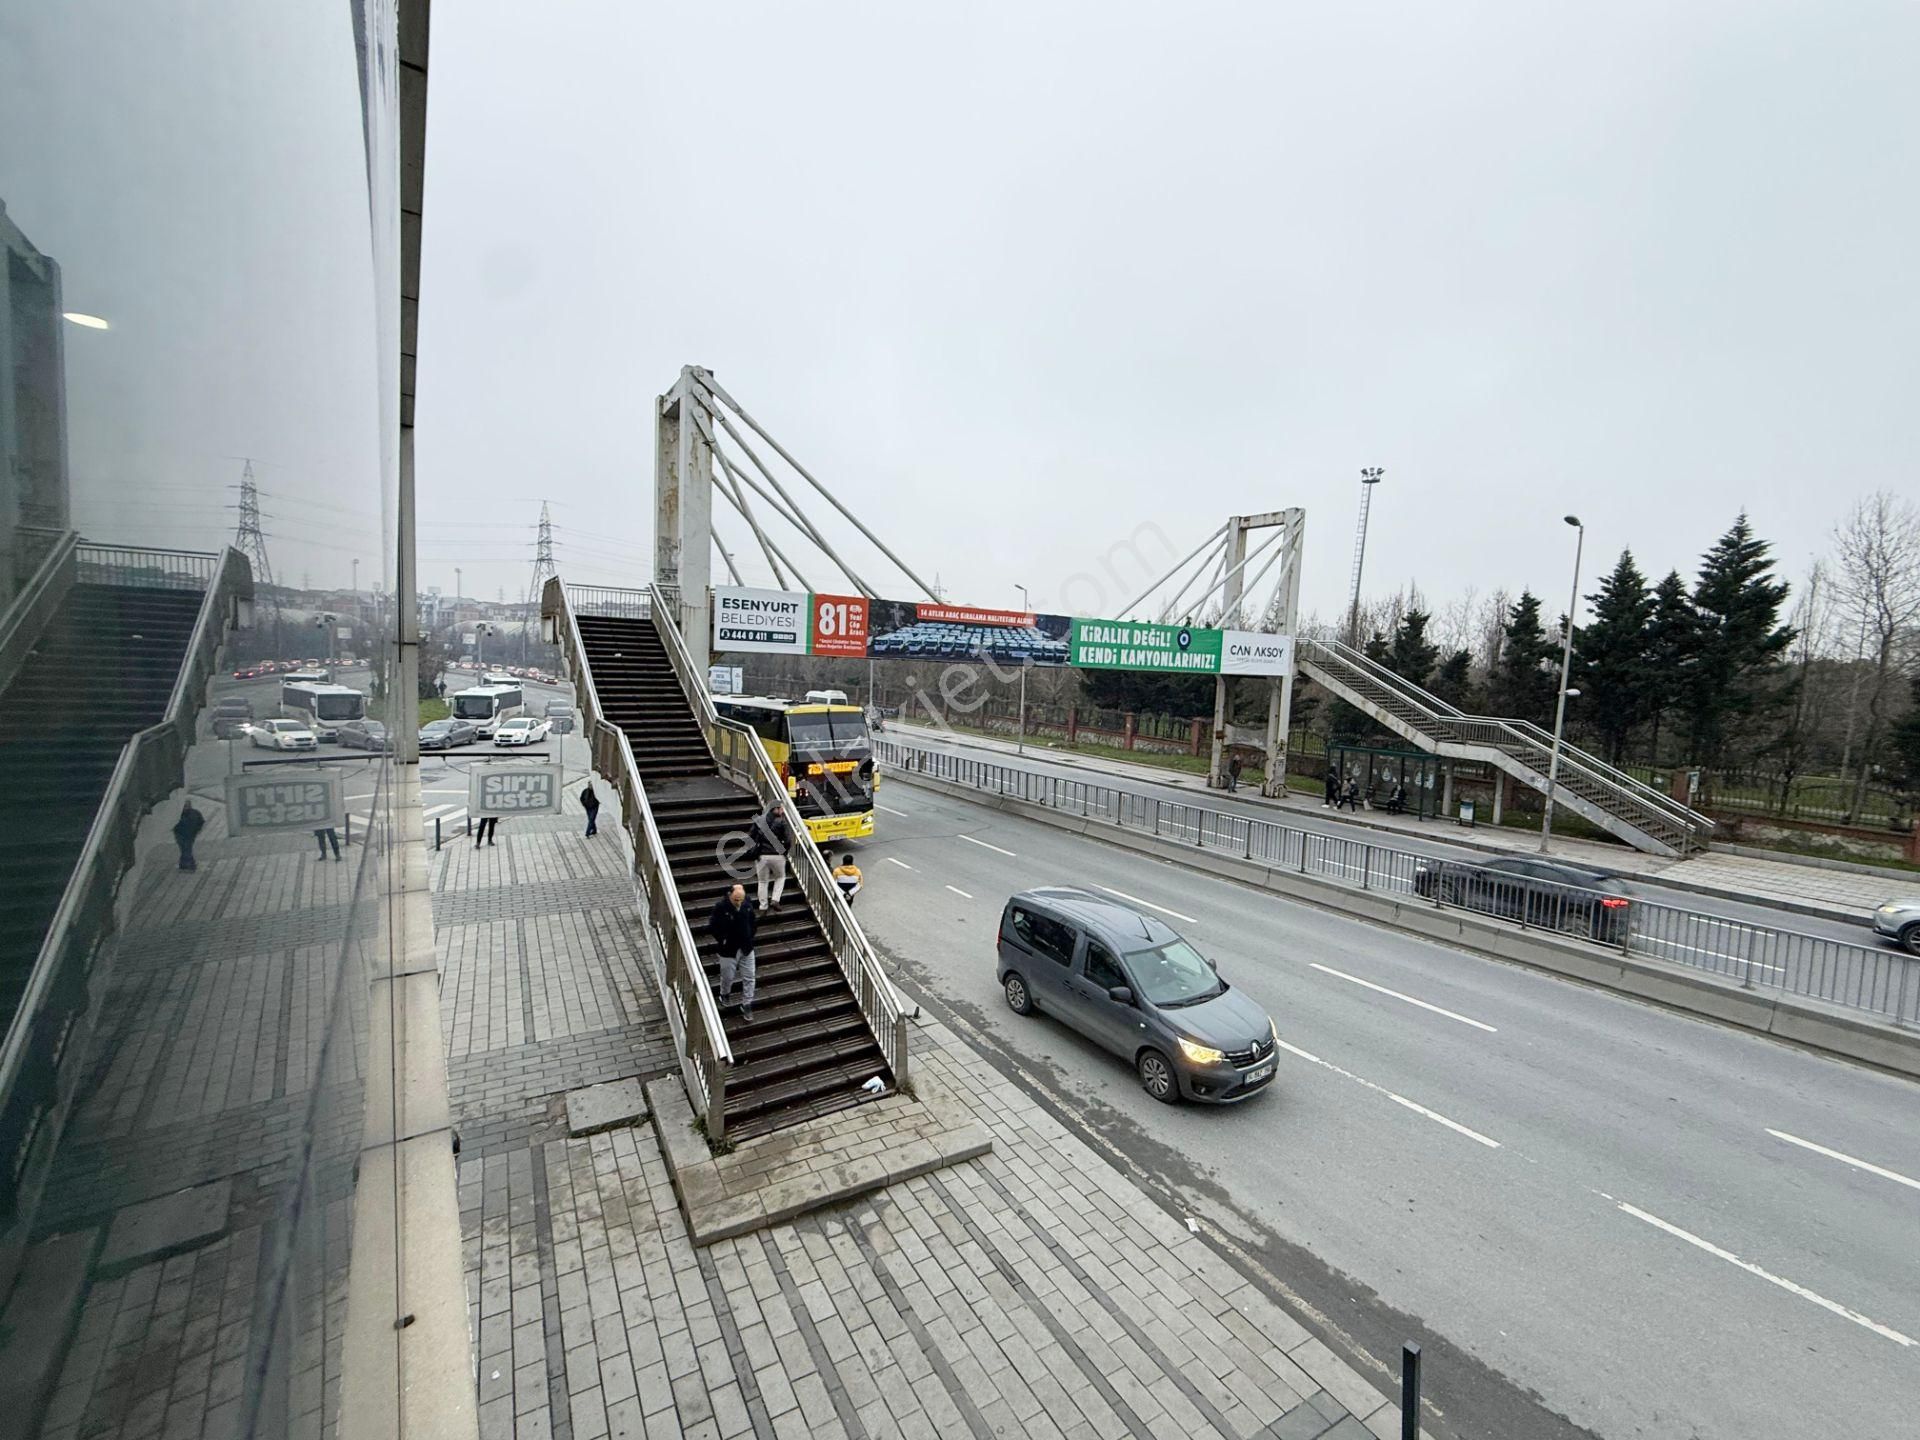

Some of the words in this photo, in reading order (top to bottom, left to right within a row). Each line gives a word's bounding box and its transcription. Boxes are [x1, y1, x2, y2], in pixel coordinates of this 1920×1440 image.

[722, 597, 799, 614] ESENYURT
[819, 602, 847, 636] 81
[731, 631, 746, 640] 444
[748, 631, 754, 640] 0
[755, 632, 767, 641] 411
[1120, 648, 1216, 669] KAMYONLARIMIZ!
[1230, 644, 1251, 656] CAN
[1254, 646, 1284, 658] AKSOY
[485, 789, 548, 809] usta
